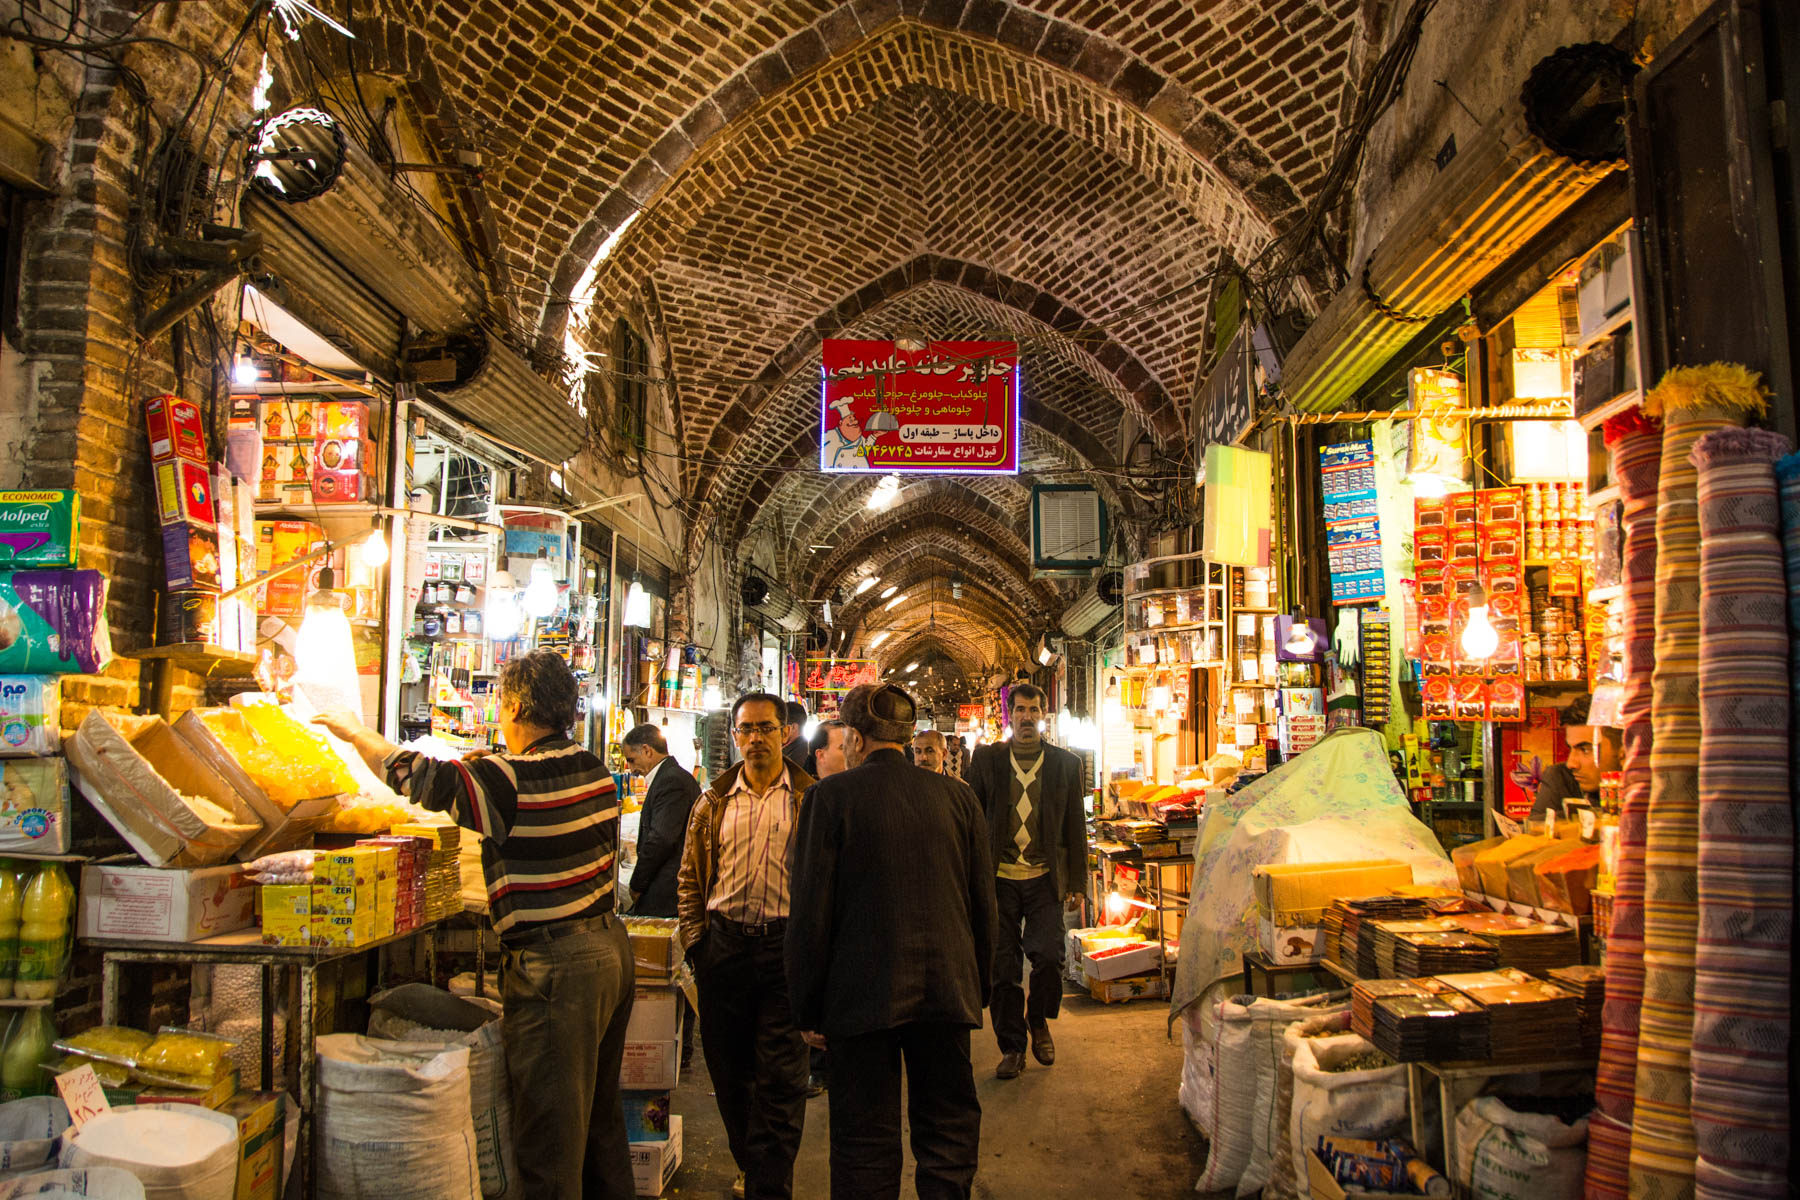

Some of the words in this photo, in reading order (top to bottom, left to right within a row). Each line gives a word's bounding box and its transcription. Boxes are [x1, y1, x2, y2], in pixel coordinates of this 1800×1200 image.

[902, 427, 918, 440] اول
[920, 427, 940, 439] طبقه
[952, 427, 974, 440] پاساژ
[976, 427, 999, 439] داخل
[2, 493, 58, 501] ECONOMIC
